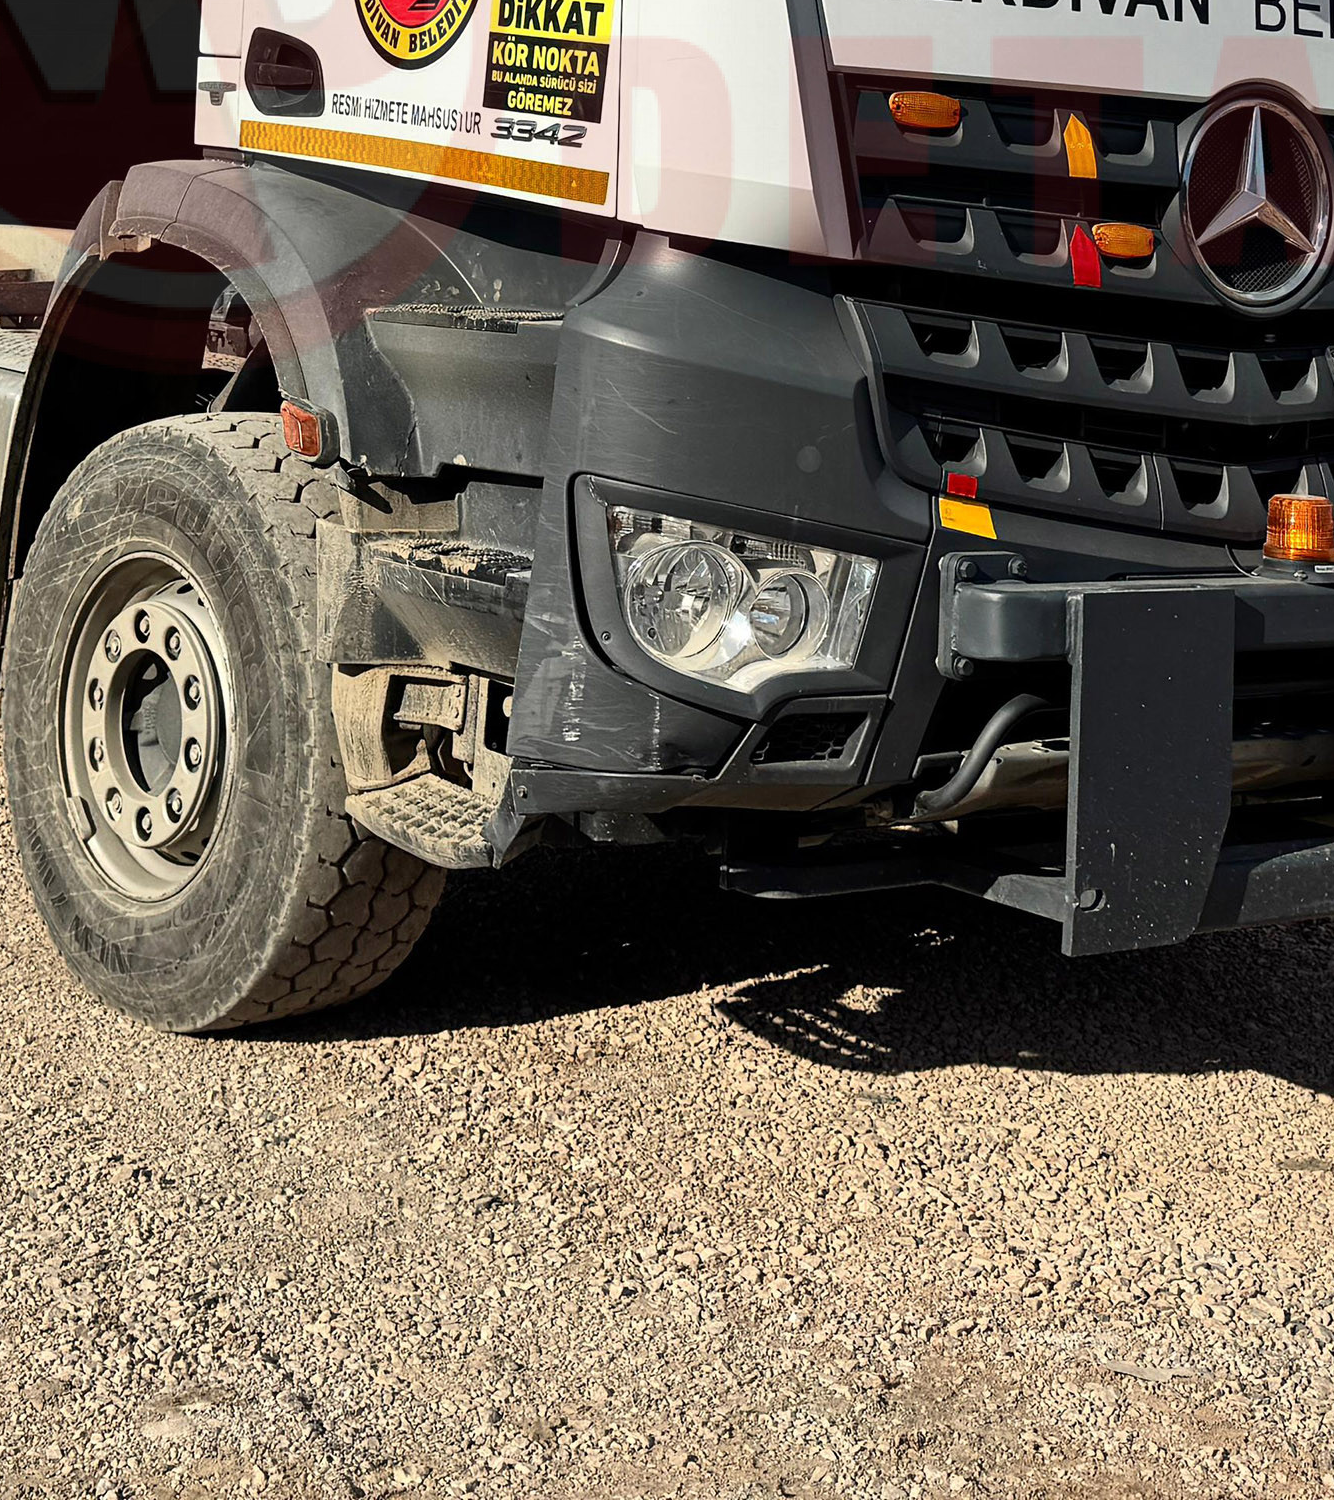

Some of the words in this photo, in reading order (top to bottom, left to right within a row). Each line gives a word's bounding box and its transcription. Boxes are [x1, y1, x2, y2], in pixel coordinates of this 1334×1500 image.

[492, 35, 529, 68] KÖR
[532, 45, 600, 76] NOKTA
[491, 70, 503, 82] BU
[504, 71, 538, 87] ALANDA
[539, 75, 576, 91] SÜRÜCÜ
[507, 87, 573, 116] GÖREMEZ
[491, 118, 587, 148] 3342
